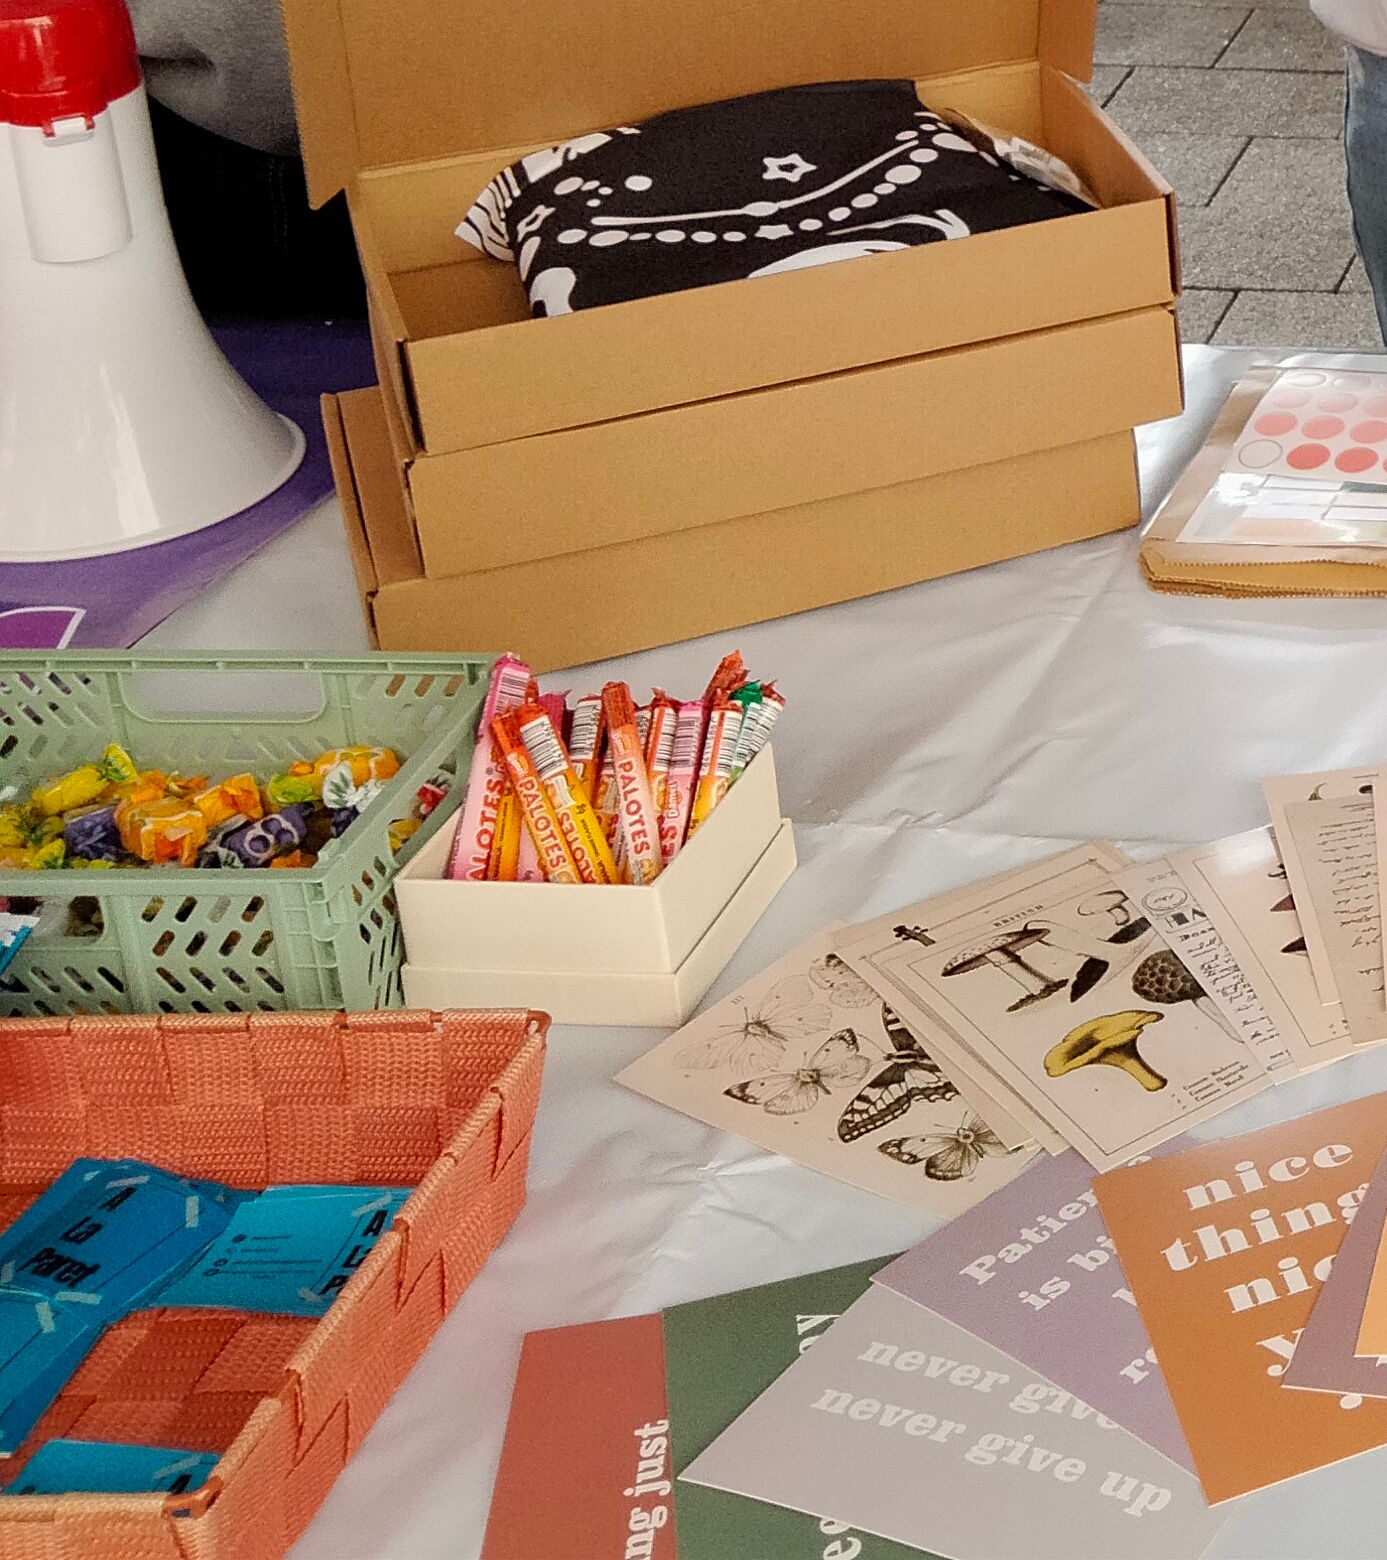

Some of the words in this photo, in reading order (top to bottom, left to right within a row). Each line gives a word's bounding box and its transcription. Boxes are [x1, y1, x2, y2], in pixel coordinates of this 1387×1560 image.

[517, 777, 567, 871] PALOTES
[618, 760, 651, 856] PALOTES
[1182, 1144, 1353, 1211] nice
[360, 1210, 388, 1238] A
[1018, 1276, 1071, 1312] is
[856, 1339, 1010, 1393] never
[623, 1418, 672, 1497] just
[810, 1389, 967, 1443] never
[963, 1432, 1087, 1483] give
[1099, 1470, 1172, 1518] up
